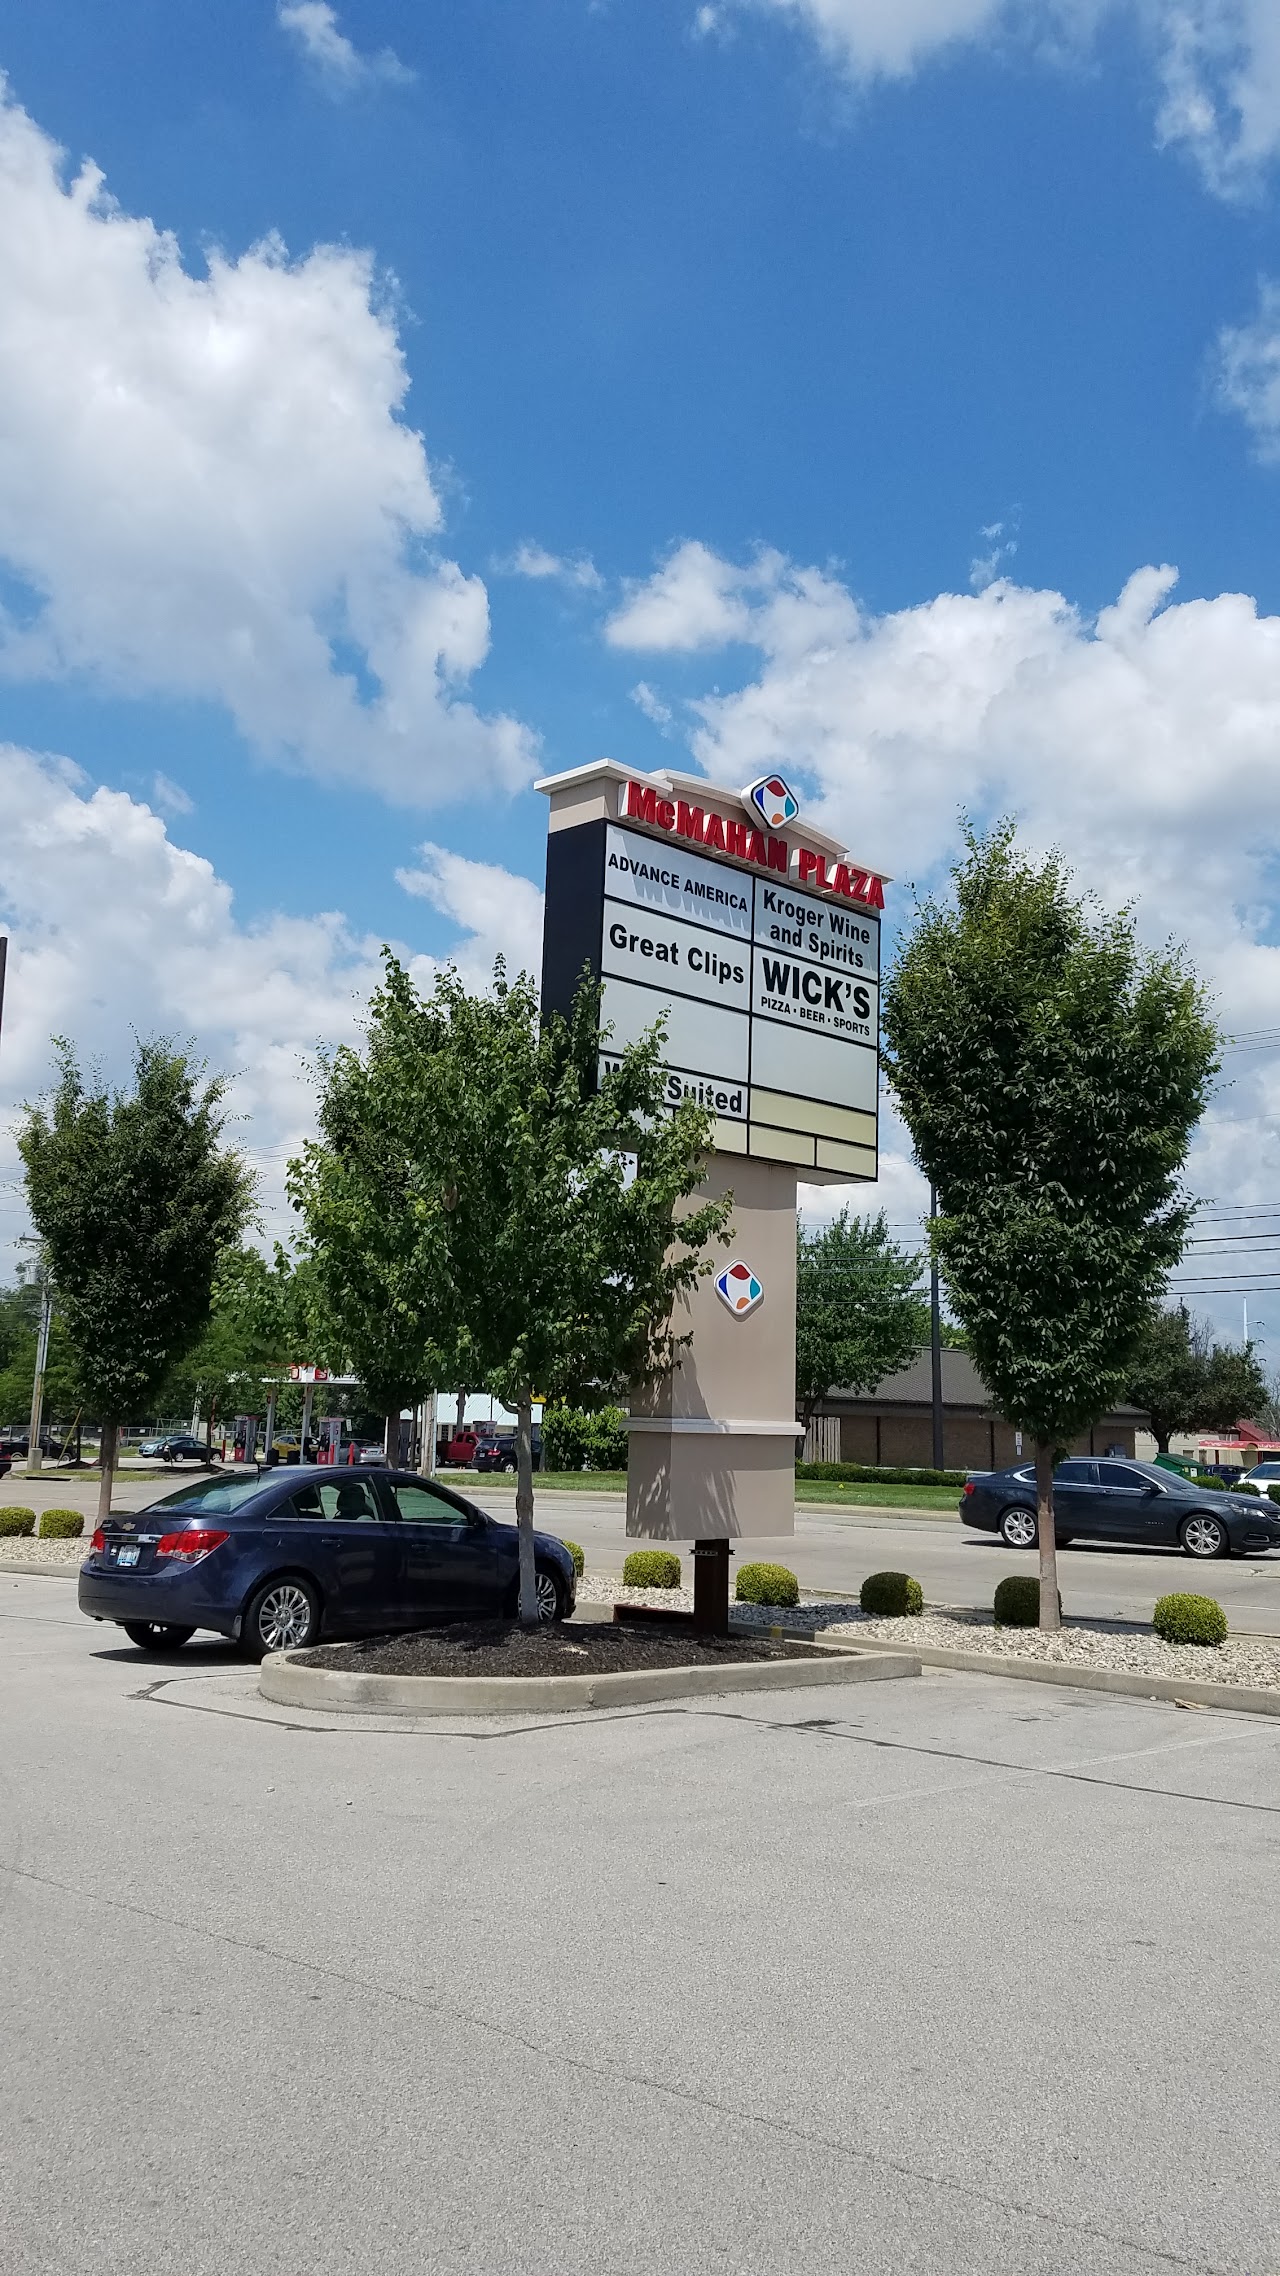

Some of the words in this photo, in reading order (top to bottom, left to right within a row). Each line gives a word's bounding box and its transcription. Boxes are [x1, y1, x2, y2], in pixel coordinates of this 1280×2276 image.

[626, 781, 788, 873] McMAHAN
[798, 848, 886, 909] PLAZA
[608, 853, 680, 890] ADVANCE
[684, 879, 748, 912] AMERICA
[763, 889, 825, 928] Kroger
[829, 912, 871, 945] Wine
[770, 924, 802, 948] and
[809, 933, 864, 968] Spirits
[609, 923, 679, 965] Great
[687, 947, 744, 984] Clips
[761, 996, 791, 1015] PIZZA
[800, 1008, 825, 1024] BEER
[833, 1017, 870, 1036] SPORTS
[762, 957, 871, 1019] WICK'S
